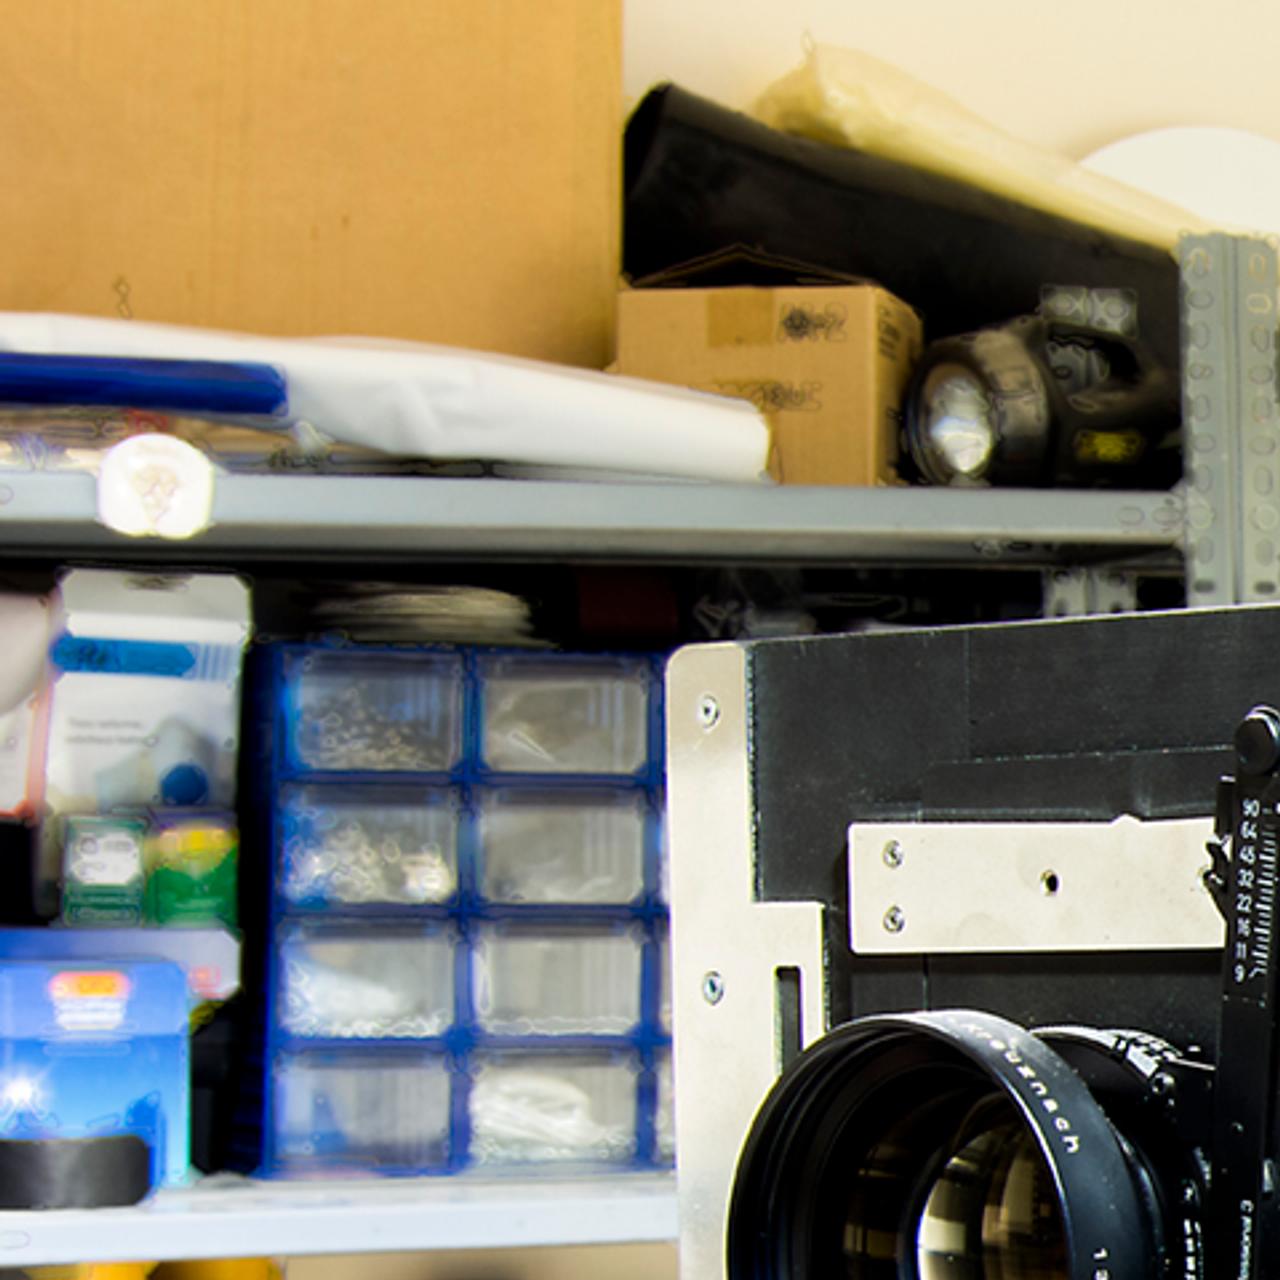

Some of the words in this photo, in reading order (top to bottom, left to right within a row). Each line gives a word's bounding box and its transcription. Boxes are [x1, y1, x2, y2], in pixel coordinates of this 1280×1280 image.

[1242, 798, 1260, 817] 90
[1240, 822, 1258, 840] 64
[1237, 869, 1255, 888] 32
[1235, 893, 1252, 913] 22
[1236, 917, 1251, 937] 16
[1234, 942, 1247, 960] 11
[1233, 964, 1246, 984] 9
